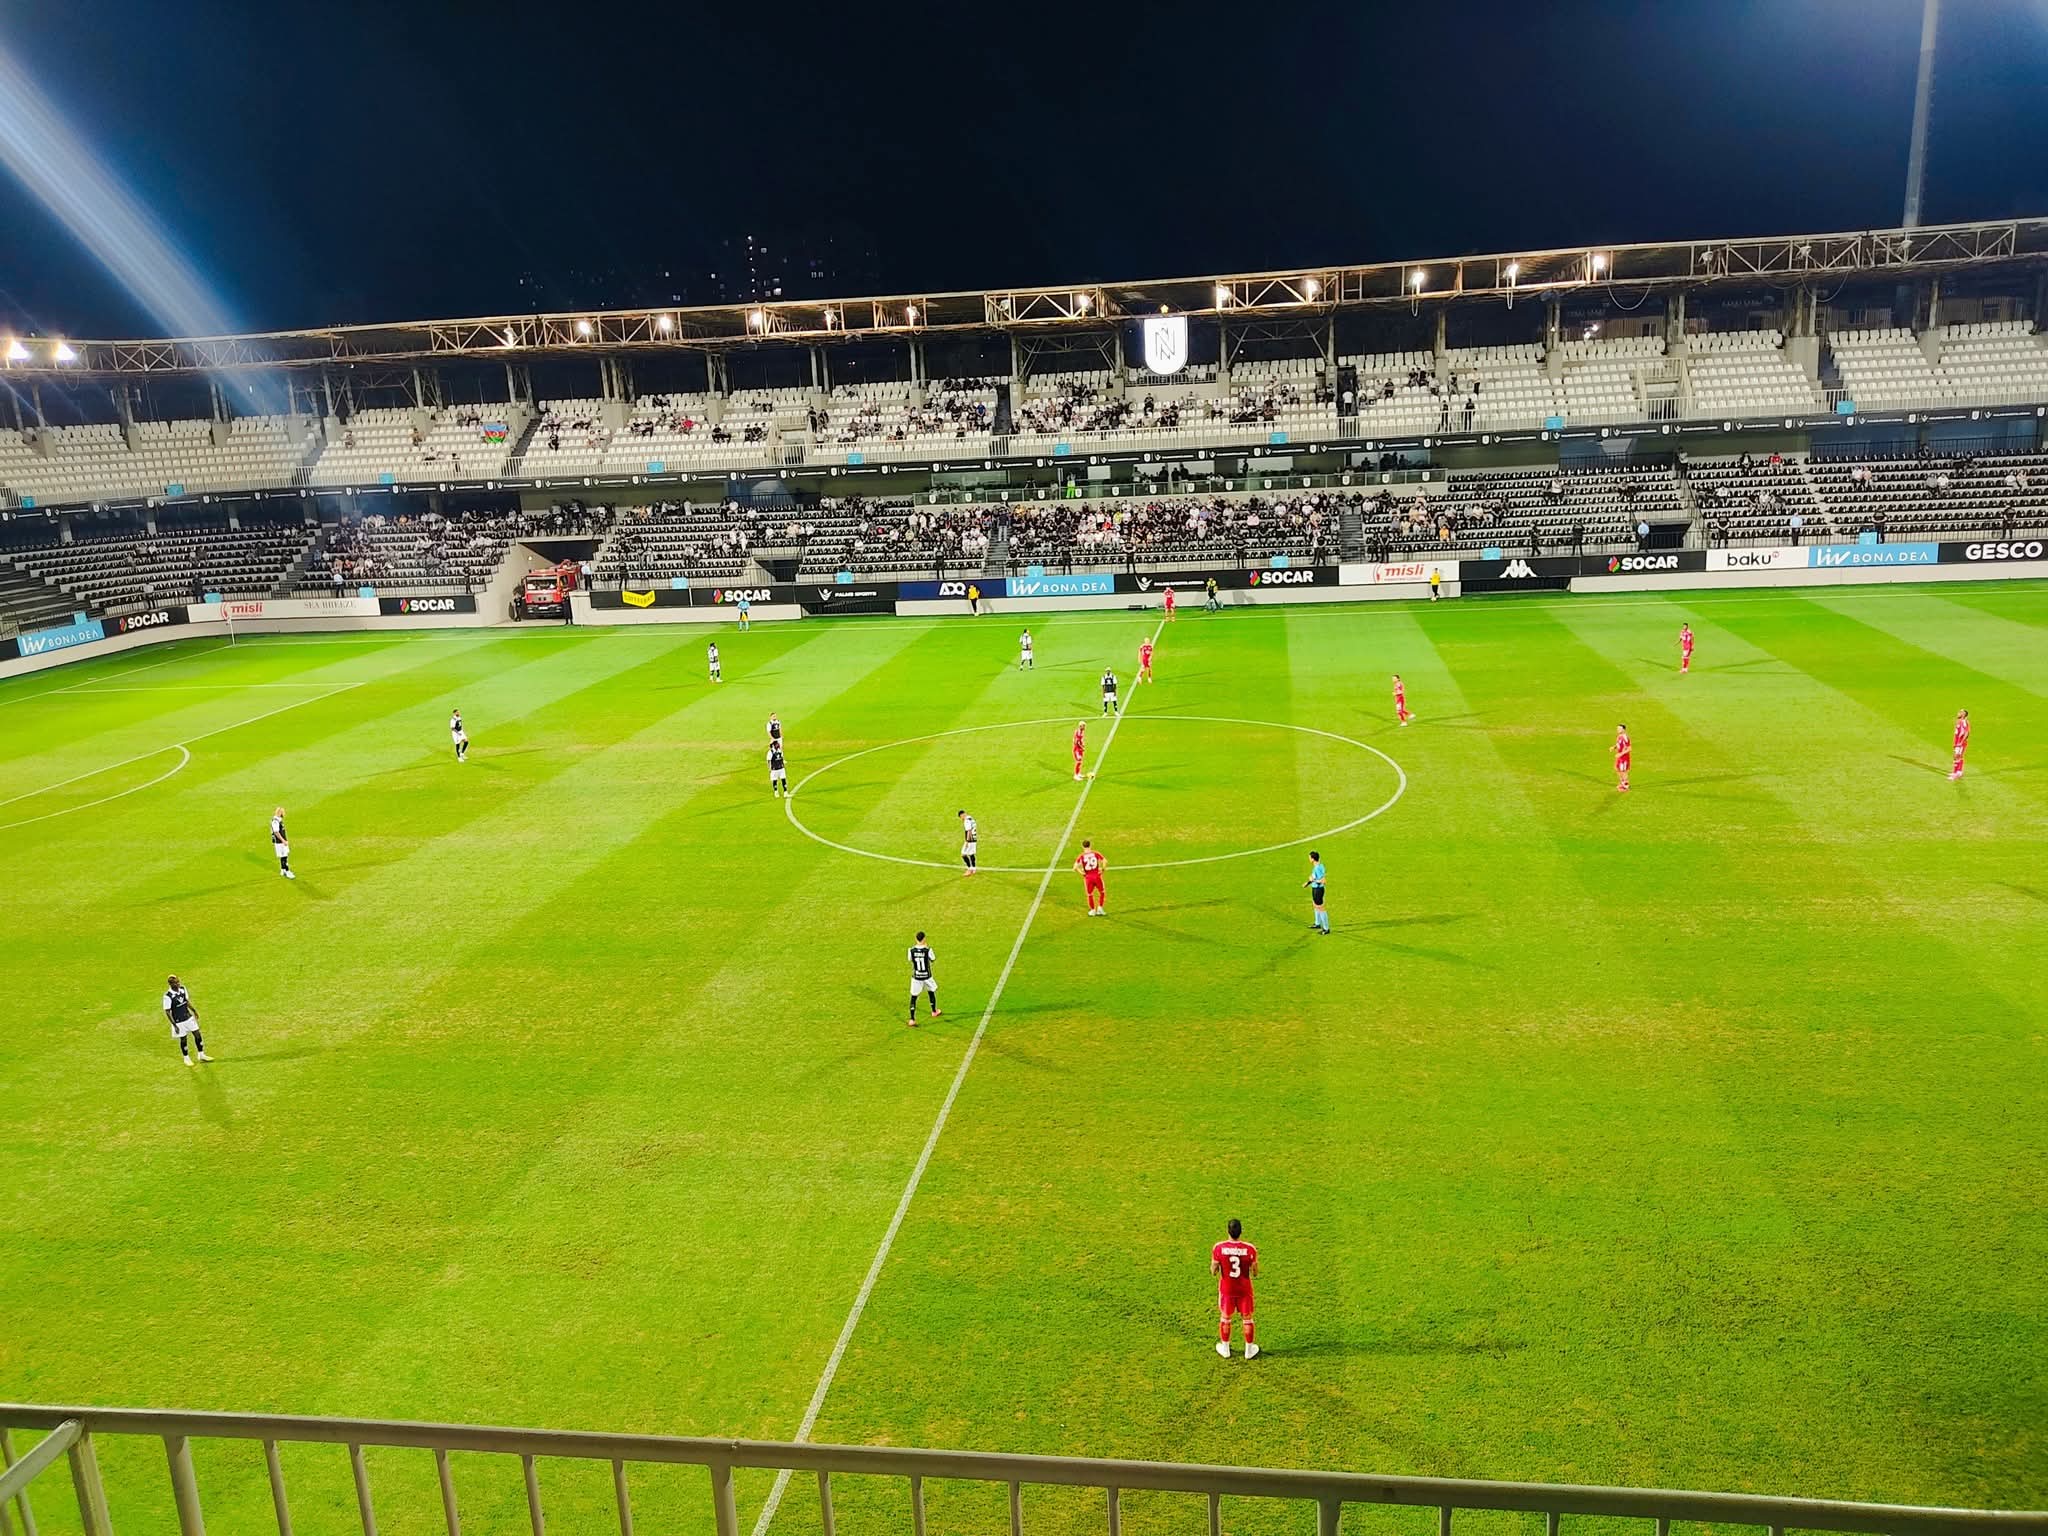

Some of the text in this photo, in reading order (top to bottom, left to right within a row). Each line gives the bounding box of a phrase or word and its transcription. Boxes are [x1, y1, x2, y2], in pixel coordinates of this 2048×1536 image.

[1852, 552, 1894, 563] BONA
[1899, 551, 1928, 561] DEA
[1965, 542, 2043, 560] GESCO
[1621, 555, 1679, 570] SOCAR
[1727, 552, 1772, 567] baku
[1261, 570, 1314, 585] SOCAR
[1384, 564, 1425, 577] misli
[724, 588, 771, 602] SOCAR
[938, 582, 966, 597] ADQ
[1042, 584, 1077, 593] BONA
[1082, 582, 1108, 592] DEA
[230, 602, 264, 615] misli
[410, 599, 455, 611] SOCAR
[127, 611, 170, 630] SOCAR
[48, 635, 77, 648] BONA
[79, 630, 99, 640] DEA
[914, 957, 926, 971] 11
[1229, 1256, 1241, 1279] 3
